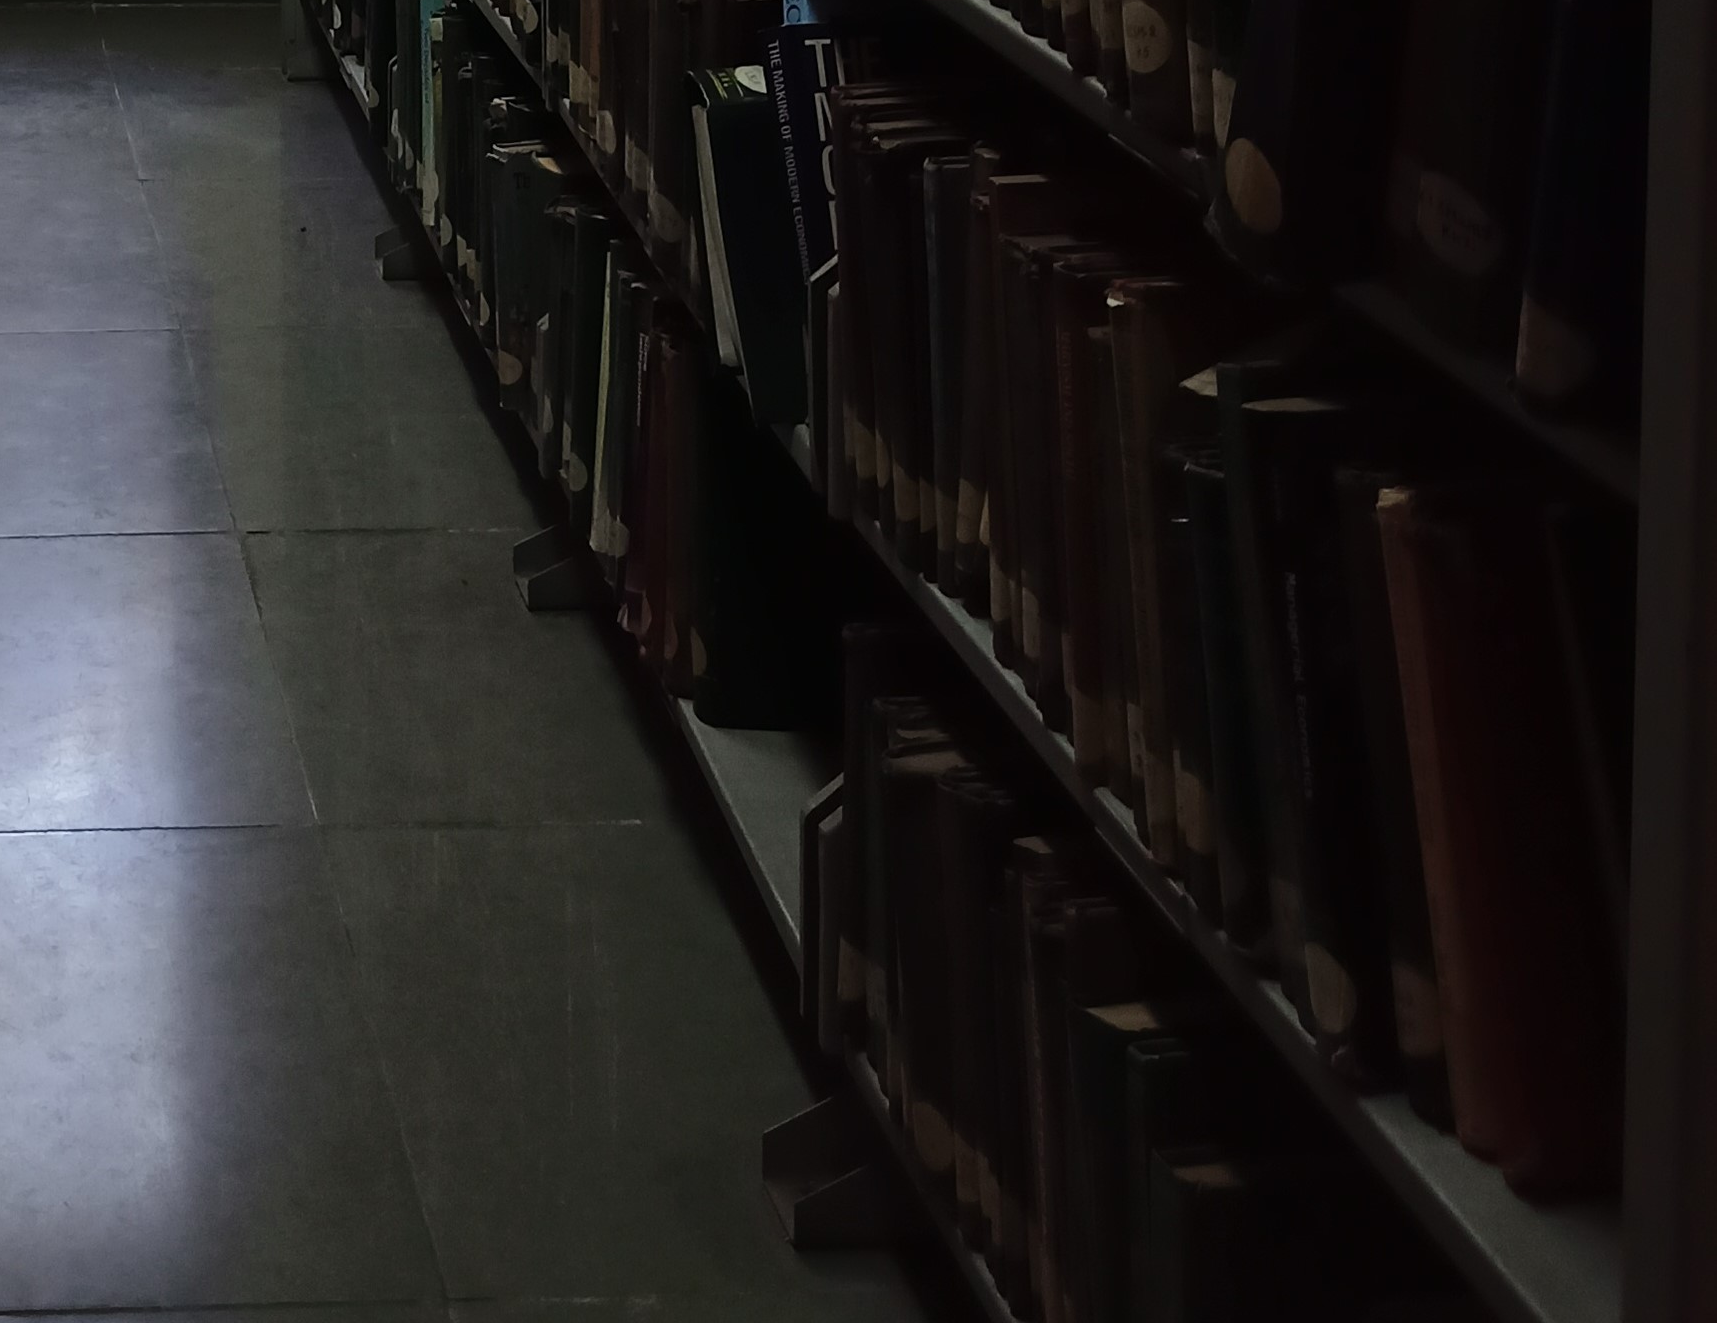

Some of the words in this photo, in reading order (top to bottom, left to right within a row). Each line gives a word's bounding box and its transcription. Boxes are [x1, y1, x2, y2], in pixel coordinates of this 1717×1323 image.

[767, 39, 782, 68] THE
[770, 70, 790, 123] MAKING
[779, 124, 794, 143] OF
[783, 145, 802, 203] MODERN
[792, 206, 812, 286] ECONOMICS
[1284, 572, 1304, 682] Managerial
[1296, 695, 1314, 799] Economics
